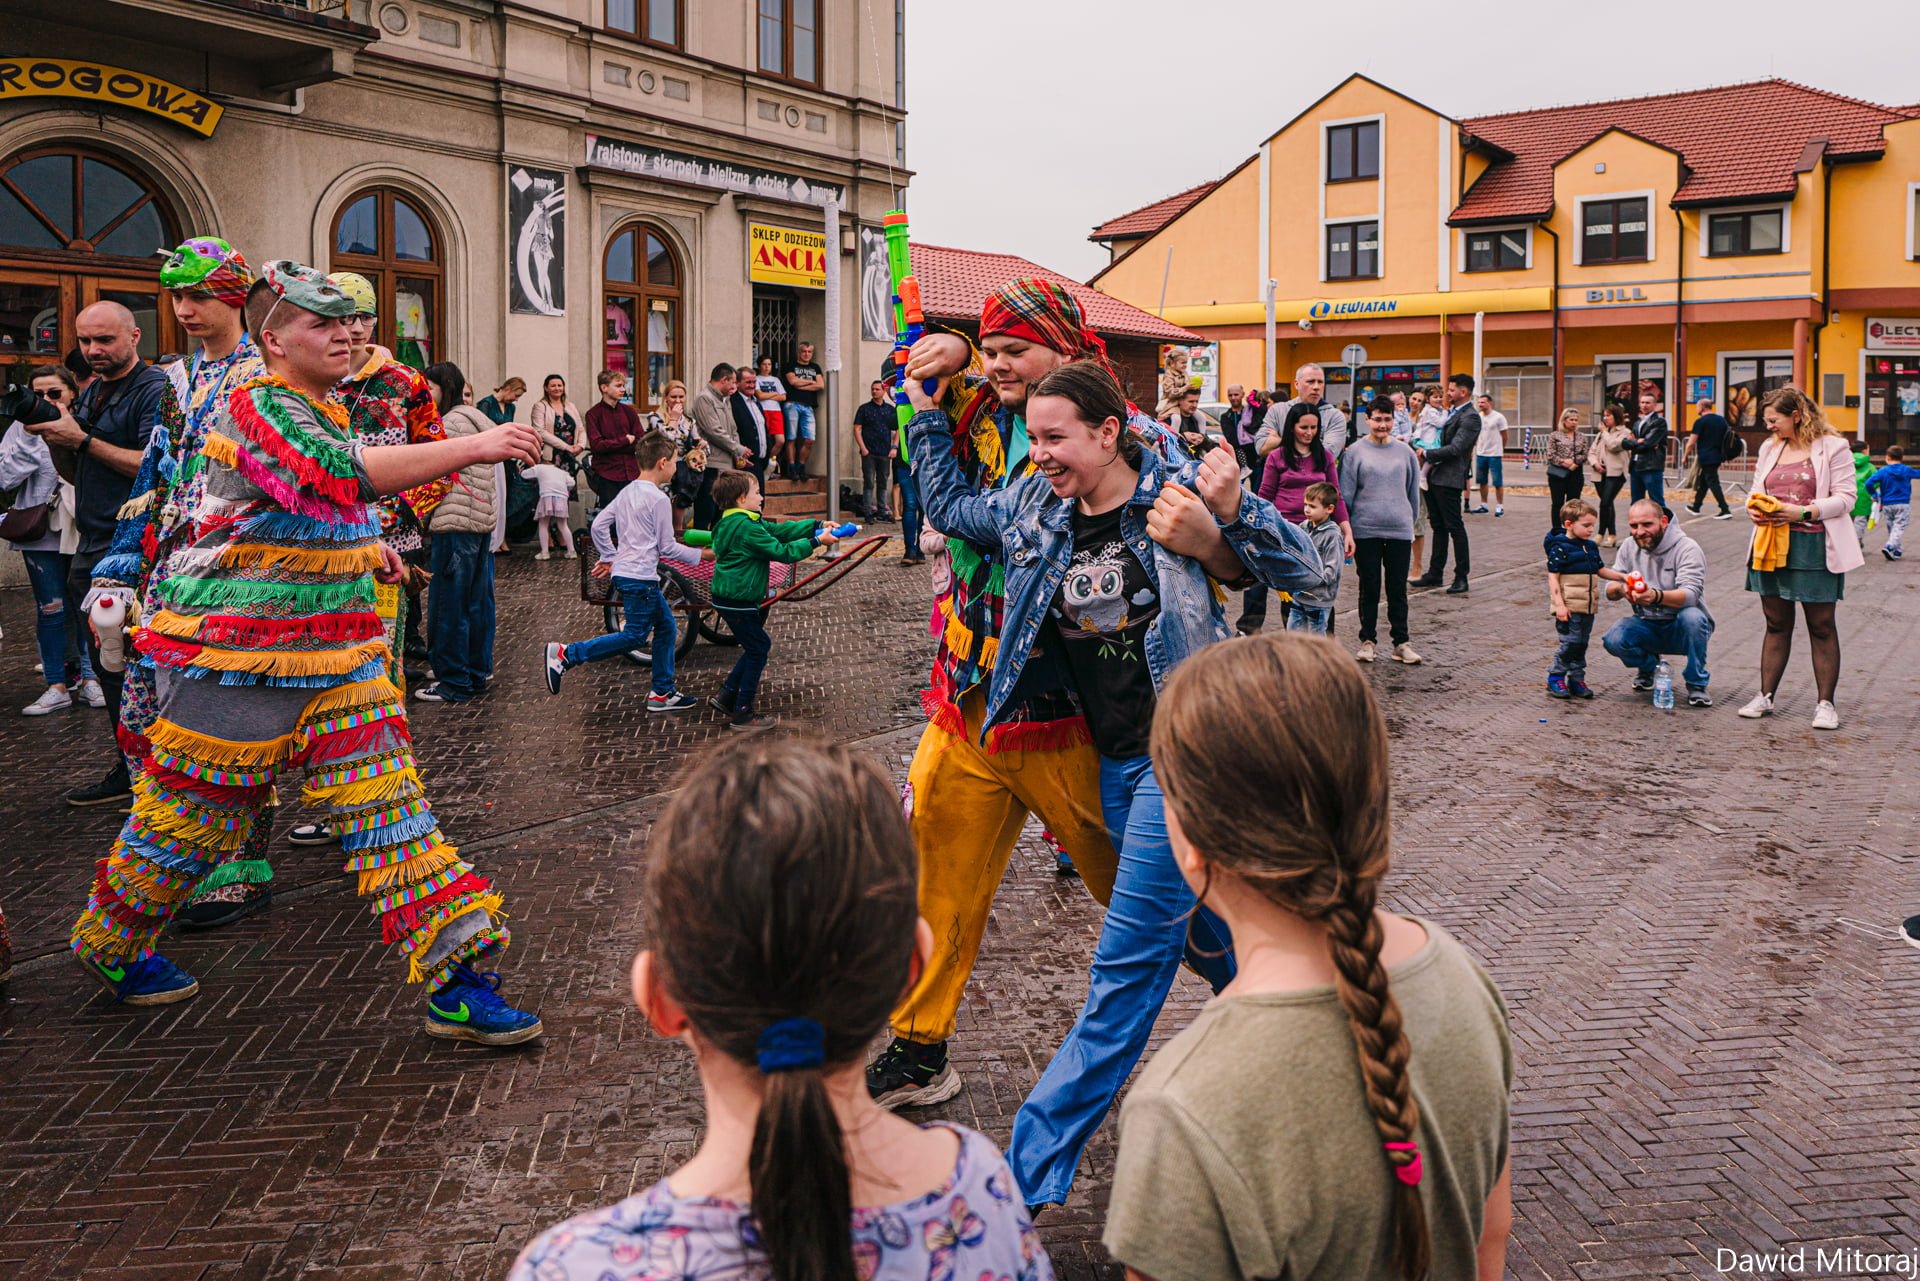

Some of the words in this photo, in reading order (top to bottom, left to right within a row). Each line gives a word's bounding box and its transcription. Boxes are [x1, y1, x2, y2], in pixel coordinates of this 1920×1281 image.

[596, 143, 647, 171] rajstopy
[653, 153, 703, 180] skarpety
[708, 162, 750, 188] bielizna
[753, 227, 781, 242] SKLEP
[784, 232, 826, 249] ODZIEŻOW
[753, 243, 826, 274] ANCIA
[1586, 287, 1648, 303] BILL
[1334, 301, 1397, 314] LEWIATAN
